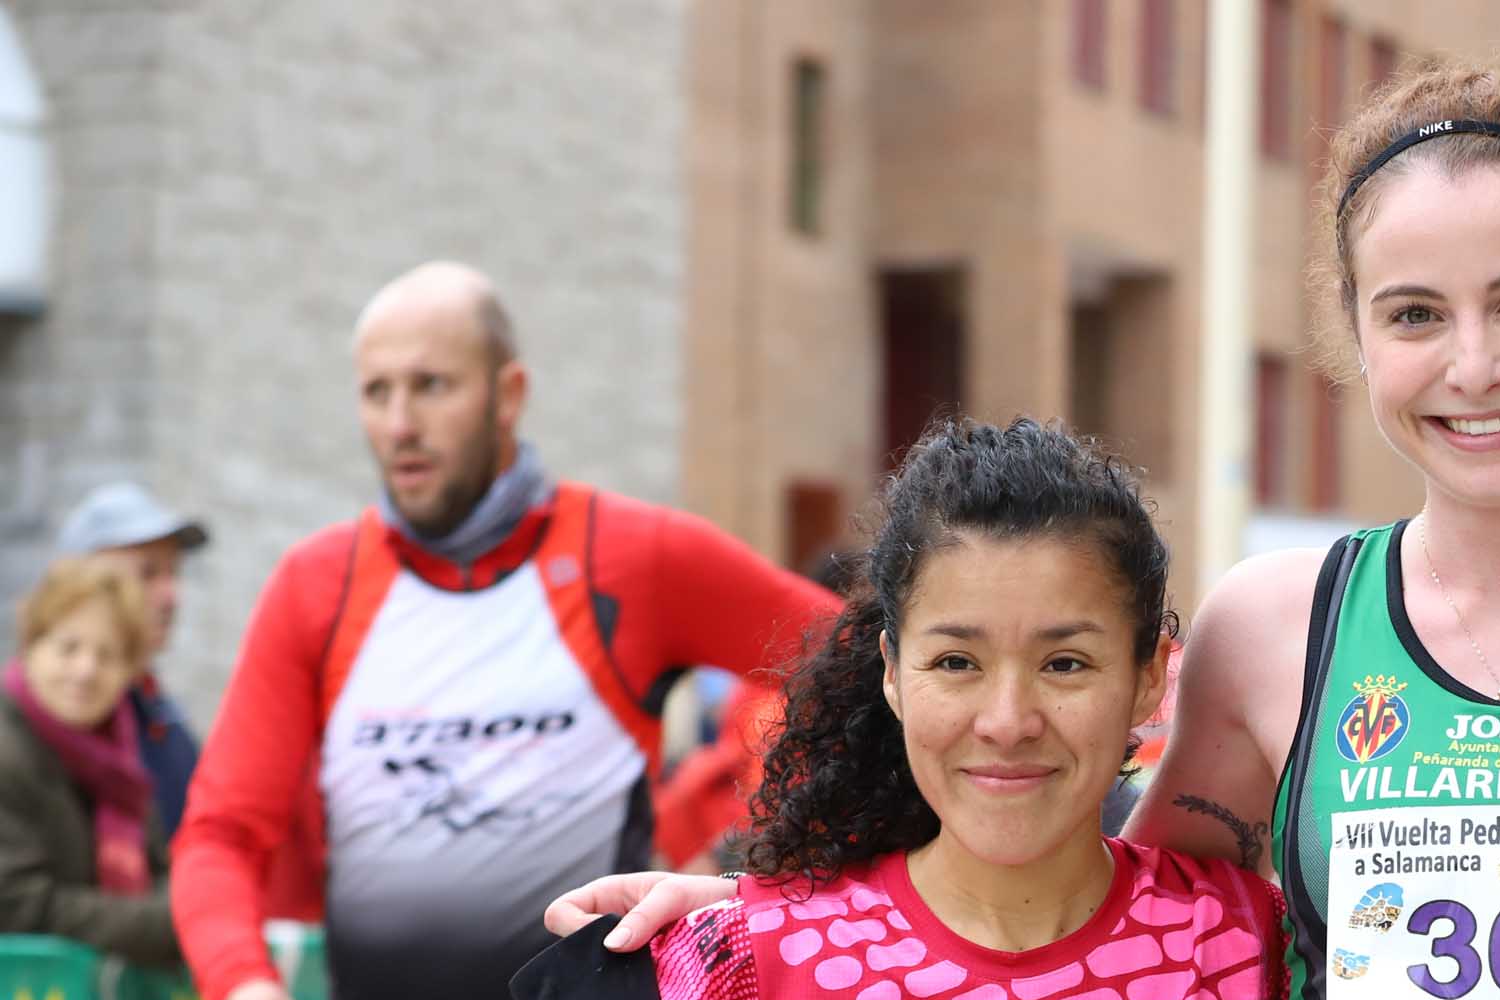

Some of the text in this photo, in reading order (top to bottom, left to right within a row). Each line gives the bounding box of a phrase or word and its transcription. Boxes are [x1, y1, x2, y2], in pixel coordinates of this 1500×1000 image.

[1419, 120, 1453, 137] NIKE
[1413, 751, 1491, 768] Peñaranda
[1379, 817, 1452, 848] Vuelta
[1355, 851, 1481, 875] a Salamanca
